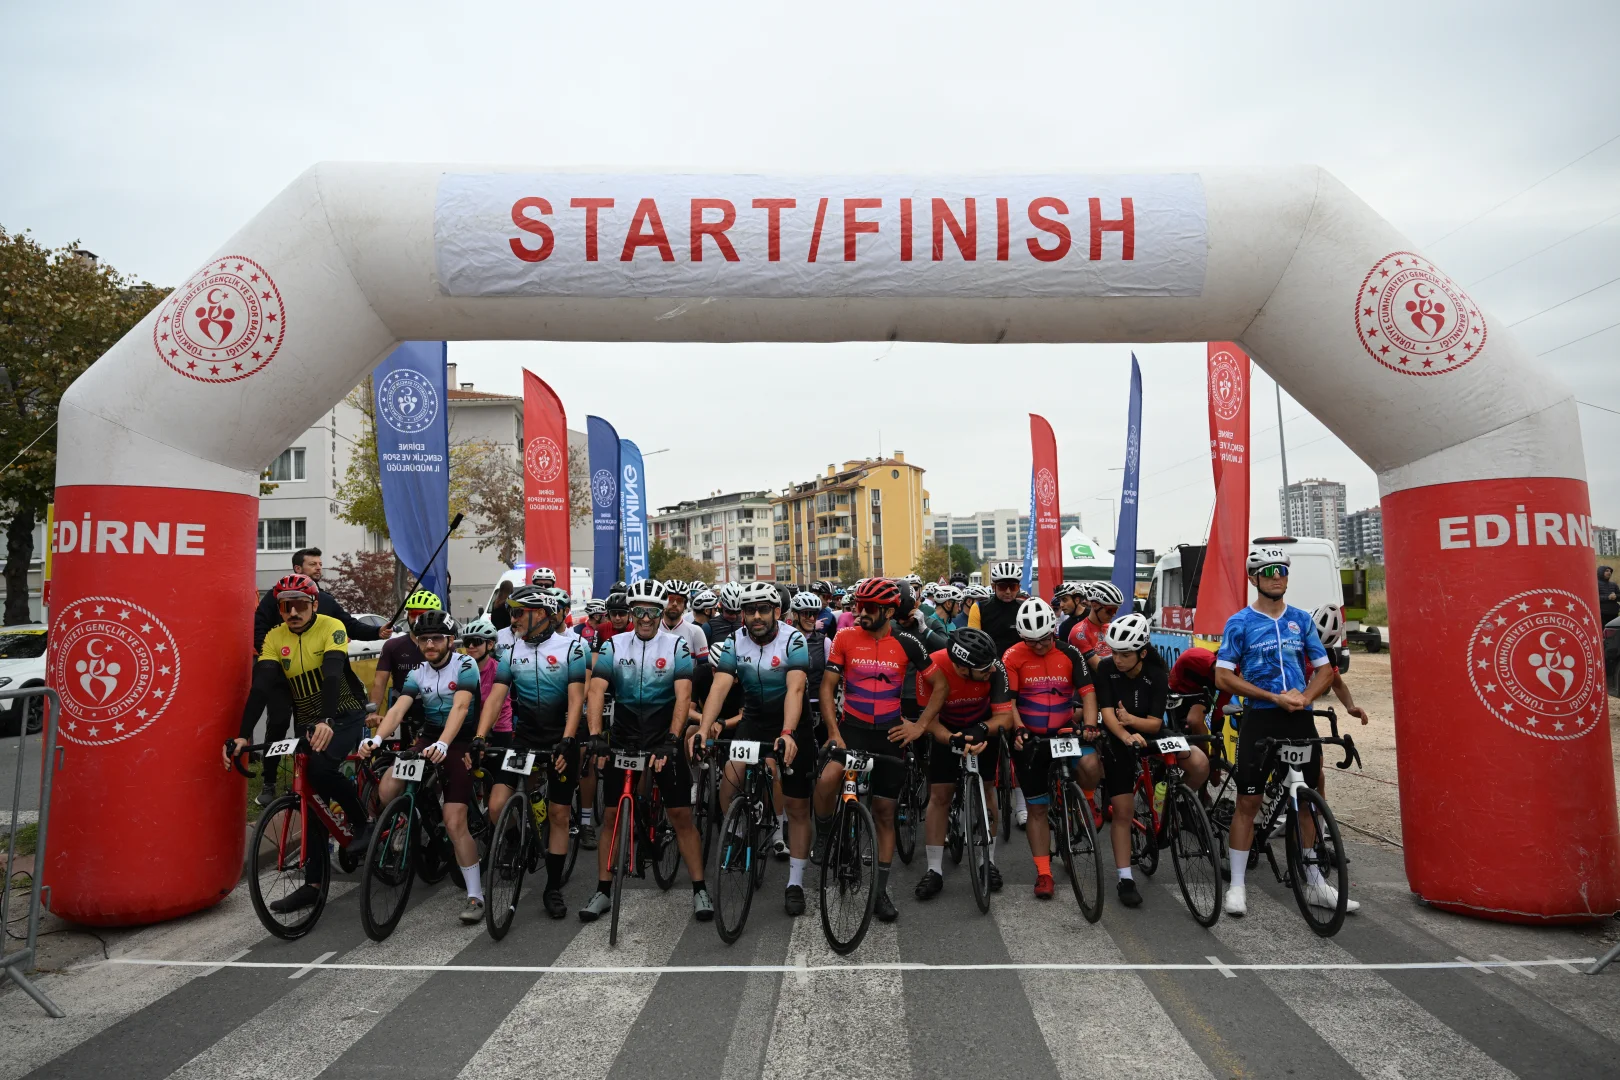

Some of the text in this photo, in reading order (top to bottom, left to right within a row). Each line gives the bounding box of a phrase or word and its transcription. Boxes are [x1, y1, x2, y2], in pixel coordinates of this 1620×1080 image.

[508, 196, 1135, 262] START/FINISH
[175, 276, 259, 356] TÜRKİYE CUMHURİYETİ GENÇLİK VE SPOR BAKANLIĞI
[1382, 271, 1465, 351] TÜRKİYE CUMHURİYETİ GENÇLİK VE SPOR BAKANLIĞI
[544, 597, 556, 605] 132
[899, 631, 927, 660] MARMARA
[953, 645, 968, 659] 158
[851, 658, 899, 669] MARMARA
[1500, 616, 1593, 710] TÜRKİYE CUMHURİYETİ GENÇLİK VE SPOR BAKANLIĞI
[58, 624, 149, 716] TÜRKİYE CUMHURİYETİ GENÇLİK VE SPOR BAKANLIĞI
[1024, 675, 1068, 683] MARMARA
[269, 743, 290, 754] 133
[1052, 741, 1073, 754] 159
[1159, 741, 1182, 750] 384
[731, 747, 751, 760] 131
[1283, 750, 1304, 762] 101
[617, 758, 637, 768] 156
[847, 759, 867, 770] 160
[395, 764, 416, 776] 110
[1261, 783, 1284, 830] COLNAGO
